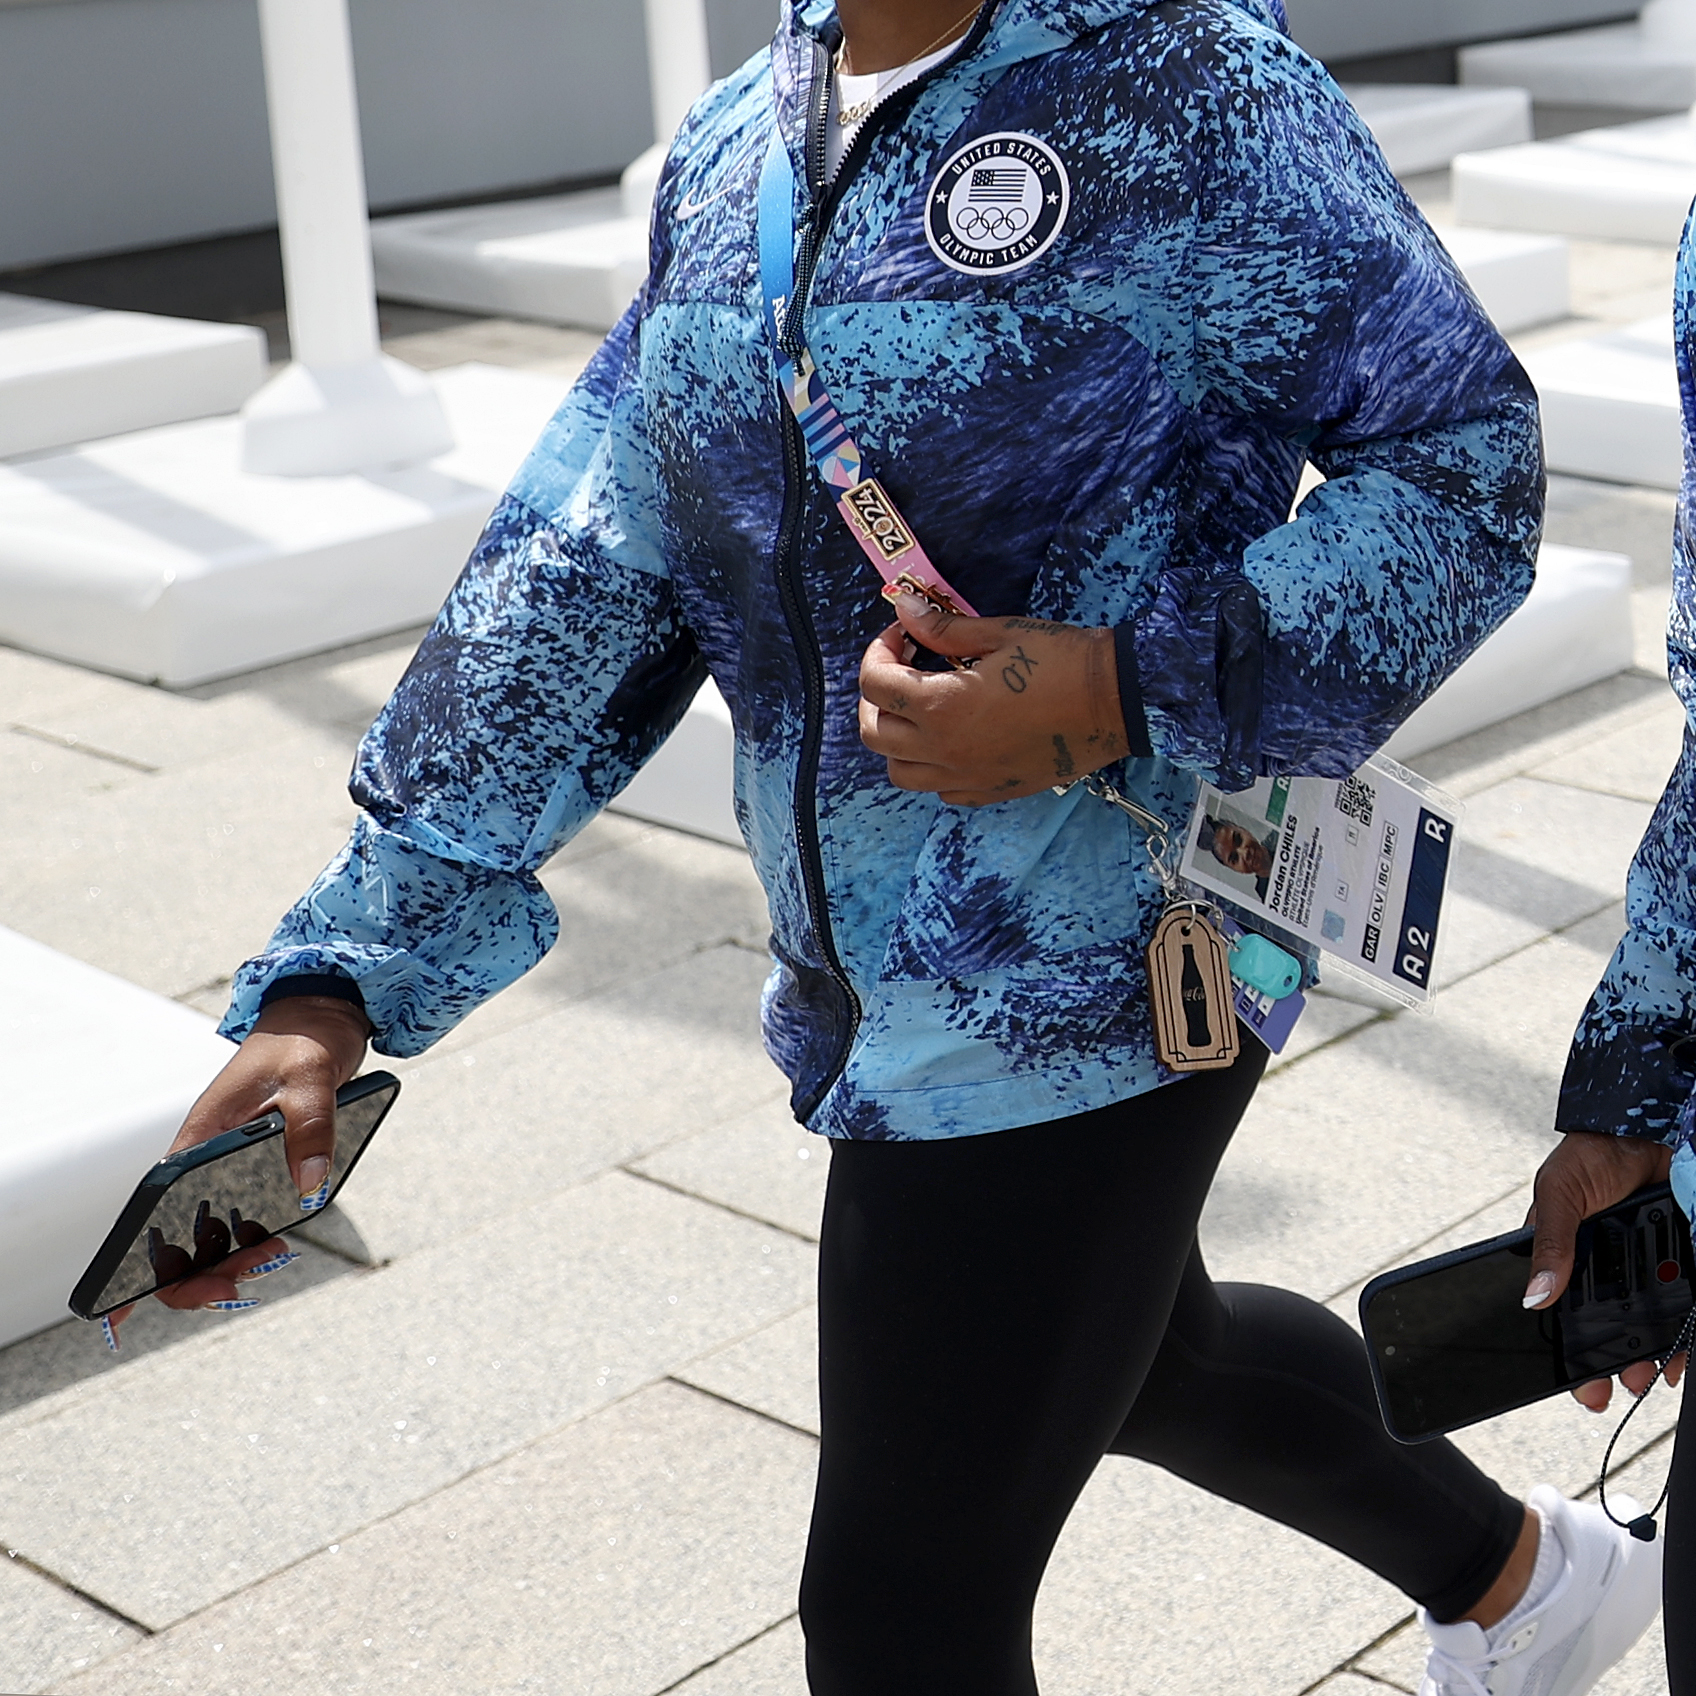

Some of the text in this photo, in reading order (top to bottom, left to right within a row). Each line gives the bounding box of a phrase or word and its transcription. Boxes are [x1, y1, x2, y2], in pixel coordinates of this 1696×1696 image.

[952, 141, 1052, 176] UNITED STATES
[939, 233, 1039, 265] OLYMPIC TEAM
[1424, 817, 1447, 844] R
[1269, 814, 1298, 914] Jordan CHILES
[1364, 826, 1398, 960] GAR OLV IBC MPC
